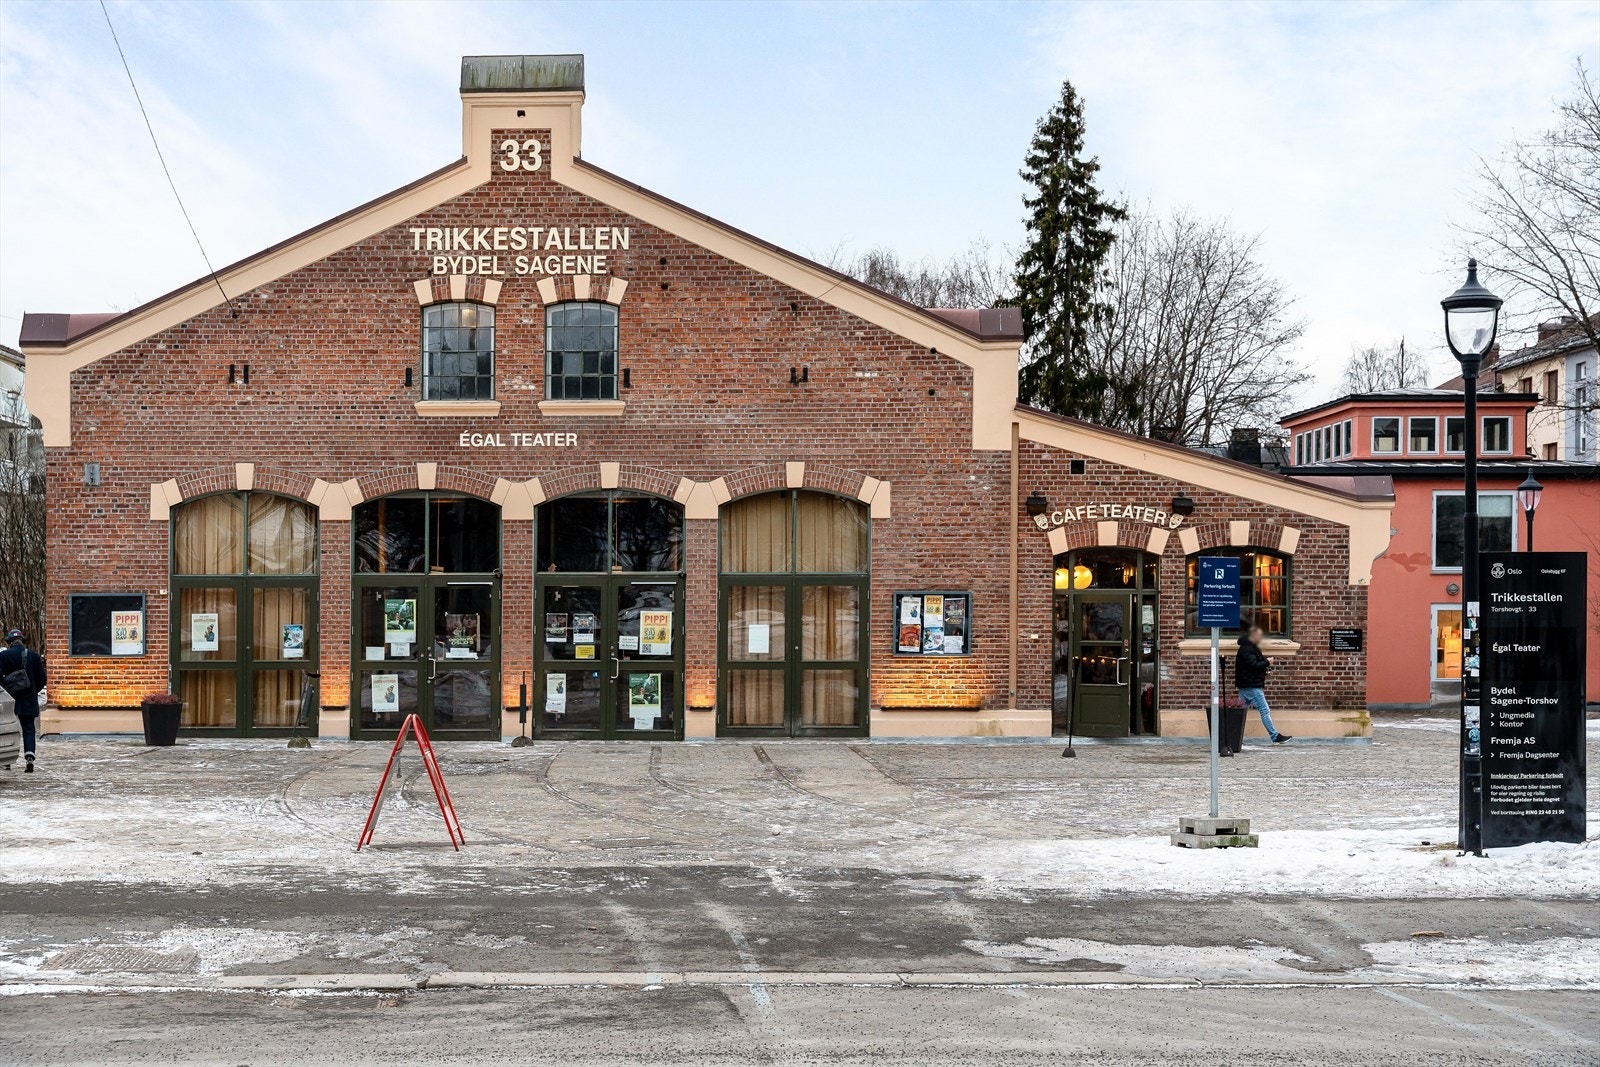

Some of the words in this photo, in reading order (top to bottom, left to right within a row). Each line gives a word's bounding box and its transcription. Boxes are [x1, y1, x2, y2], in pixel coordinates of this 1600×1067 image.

[500, 139, 543, 172] 33
[409, 226, 630, 250] TRIKKESTALLEN
[432, 255, 505, 276] BYDEL
[514, 255, 607, 275] SAGENE
[459, 430, 506, 447] ÉGAL
[510, 433, 578, 447] TEATER
[1051, 501, 1098, 525] CAFÉ
[1100, 504, 1167, 526] TEATER
[1491, 592, 1563, 602] Trikkestallen
[116, 615, 138, 623] PIPPI
[645, 615, 668, 623] PIPPI
[1492, 642, 1511, 653] Égal
[1513, 644, 1541, 652] Teater
[1491, 687, 1516, 696] Bydel
[1491, 697, 1559, 706] Sagene-Torshov
[1499, 712, 1535, 720] Ungmedia
[1491, 737, 1521, 746] Fremja
[1499, 752, 1524, 760] Fremja
